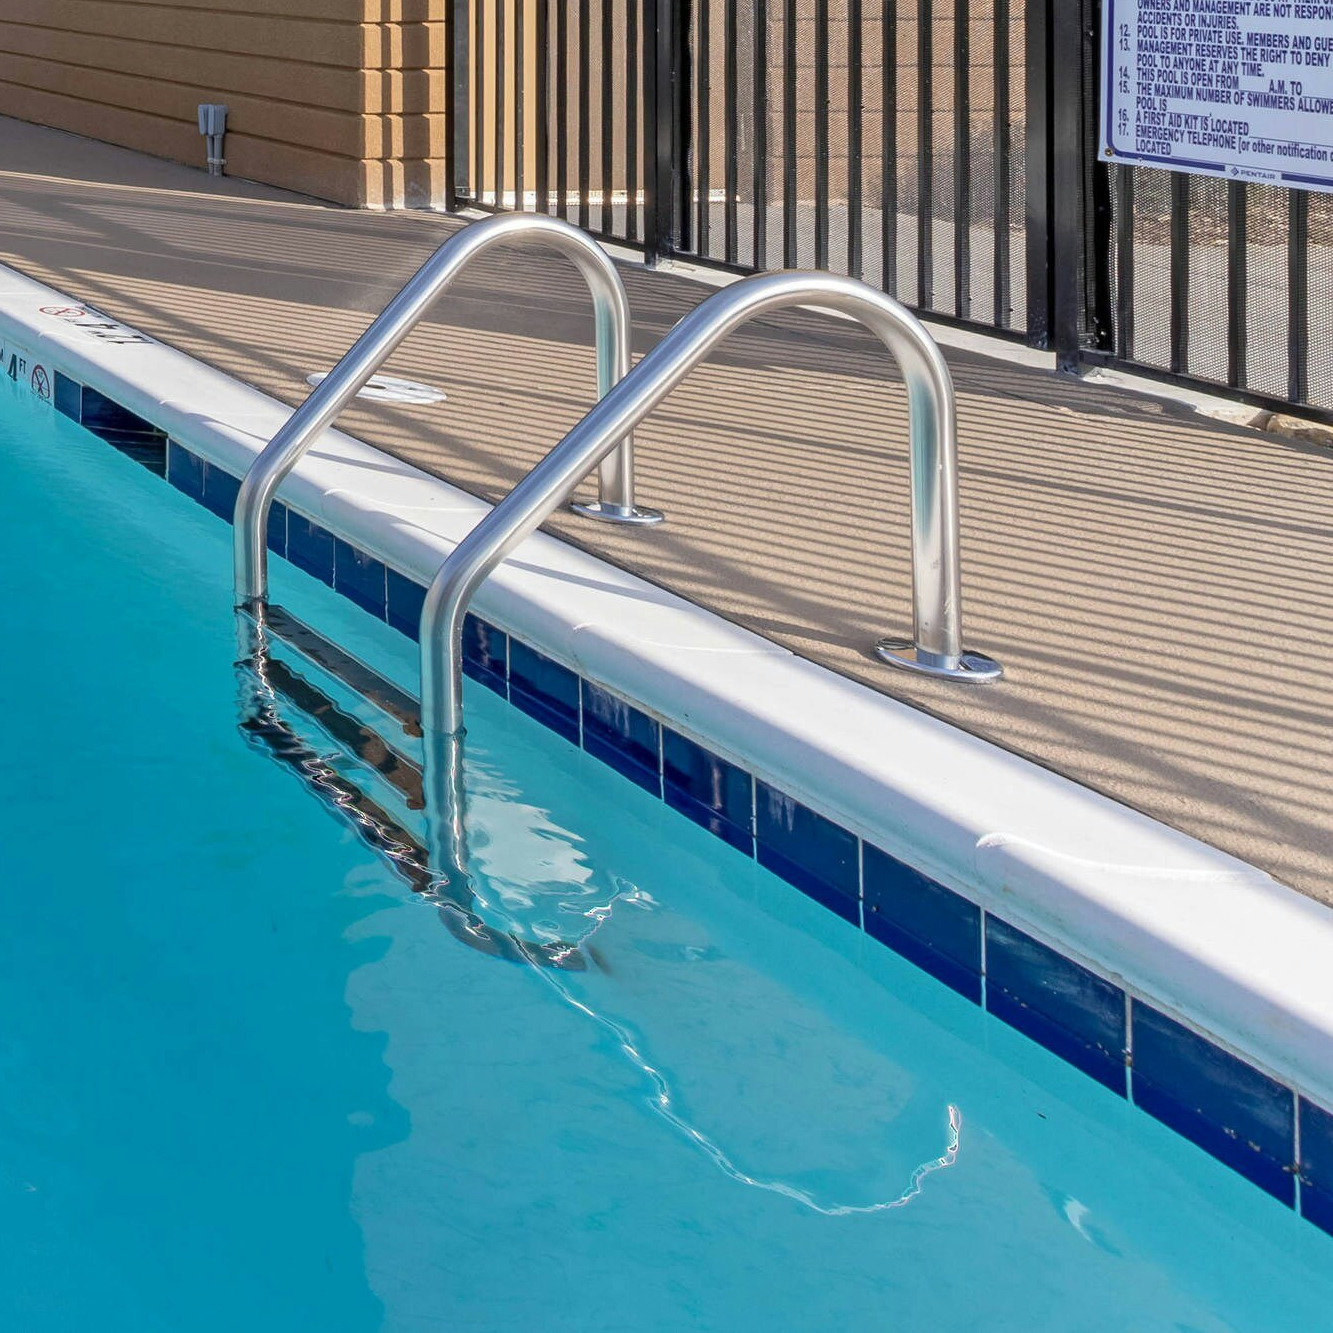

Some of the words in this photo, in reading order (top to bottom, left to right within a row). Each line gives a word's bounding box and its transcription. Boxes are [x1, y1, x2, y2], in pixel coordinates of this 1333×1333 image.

[1119, 67, 1129, 79] 14.
[1137, 67, 1154, 81] THIS
[1157, 69, 1178, 83] POOL
[1181, 71, 1188, 84] IS
[1191, 72, 1213, 87] OPEN
[1216, 74, 1239, 89] FROM
[1269, 79, 1287, 94] A.M.
[1290, 80, 1302, 95] TO
[1118, 123, 1128, 136] 17.
[1136, 125, 1184, 143] EMERGENCY
[1187, 131, 1236, 149] TELEPHONE
[1252, 140, 1274, 155] other
[1277, 144, 1327, 161] notification
[1136, 140, 1171, 155] LOCATED
